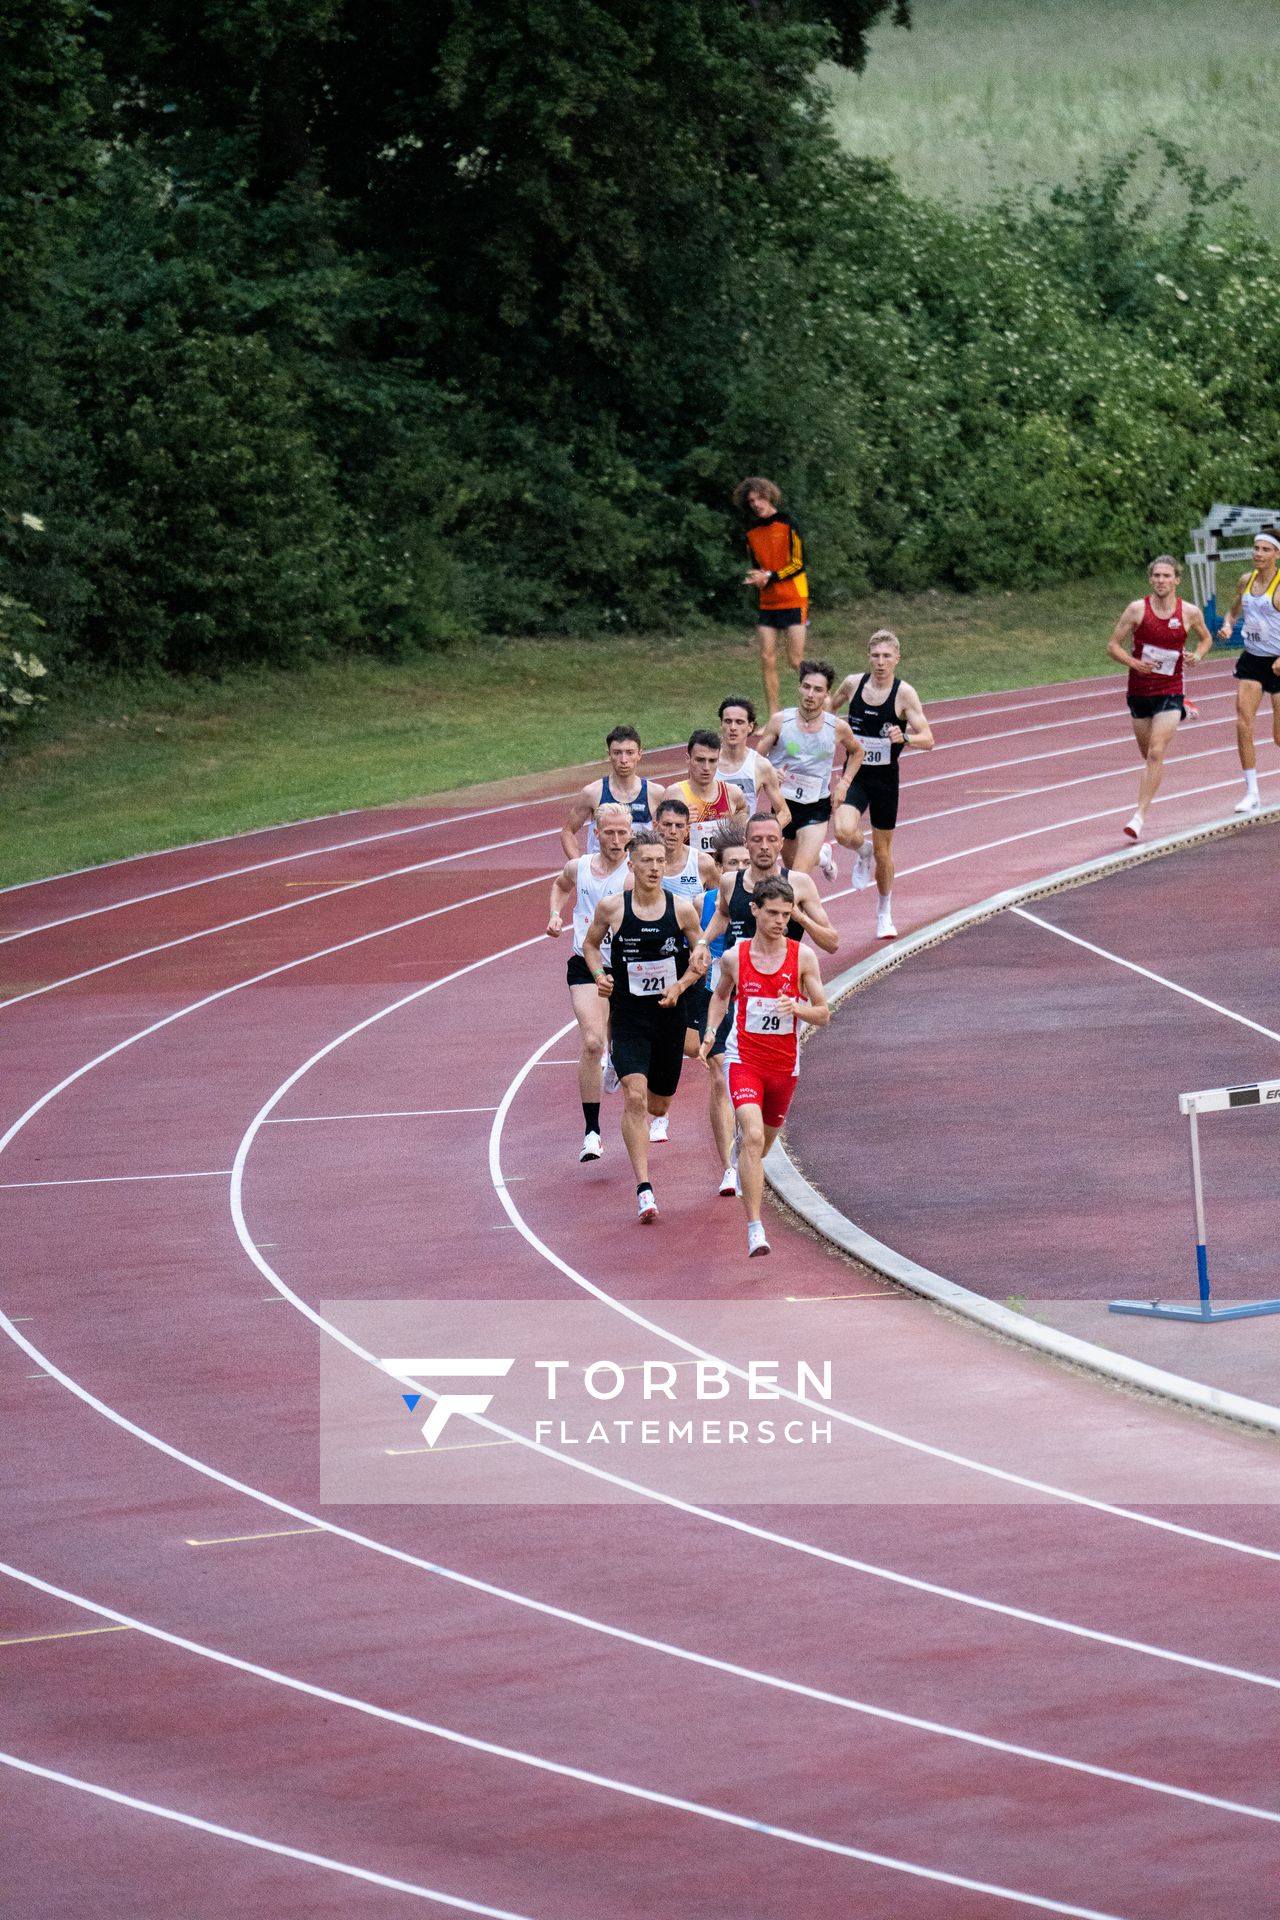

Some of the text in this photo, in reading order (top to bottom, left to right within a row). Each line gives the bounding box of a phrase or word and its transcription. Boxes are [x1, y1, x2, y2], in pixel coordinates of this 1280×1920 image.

[795, 787, 804, 800] 9
[680, 875, 697, 883] SVS
[642, 975, 666, 992] 221
[761, 1015, 780, 1031] 29
